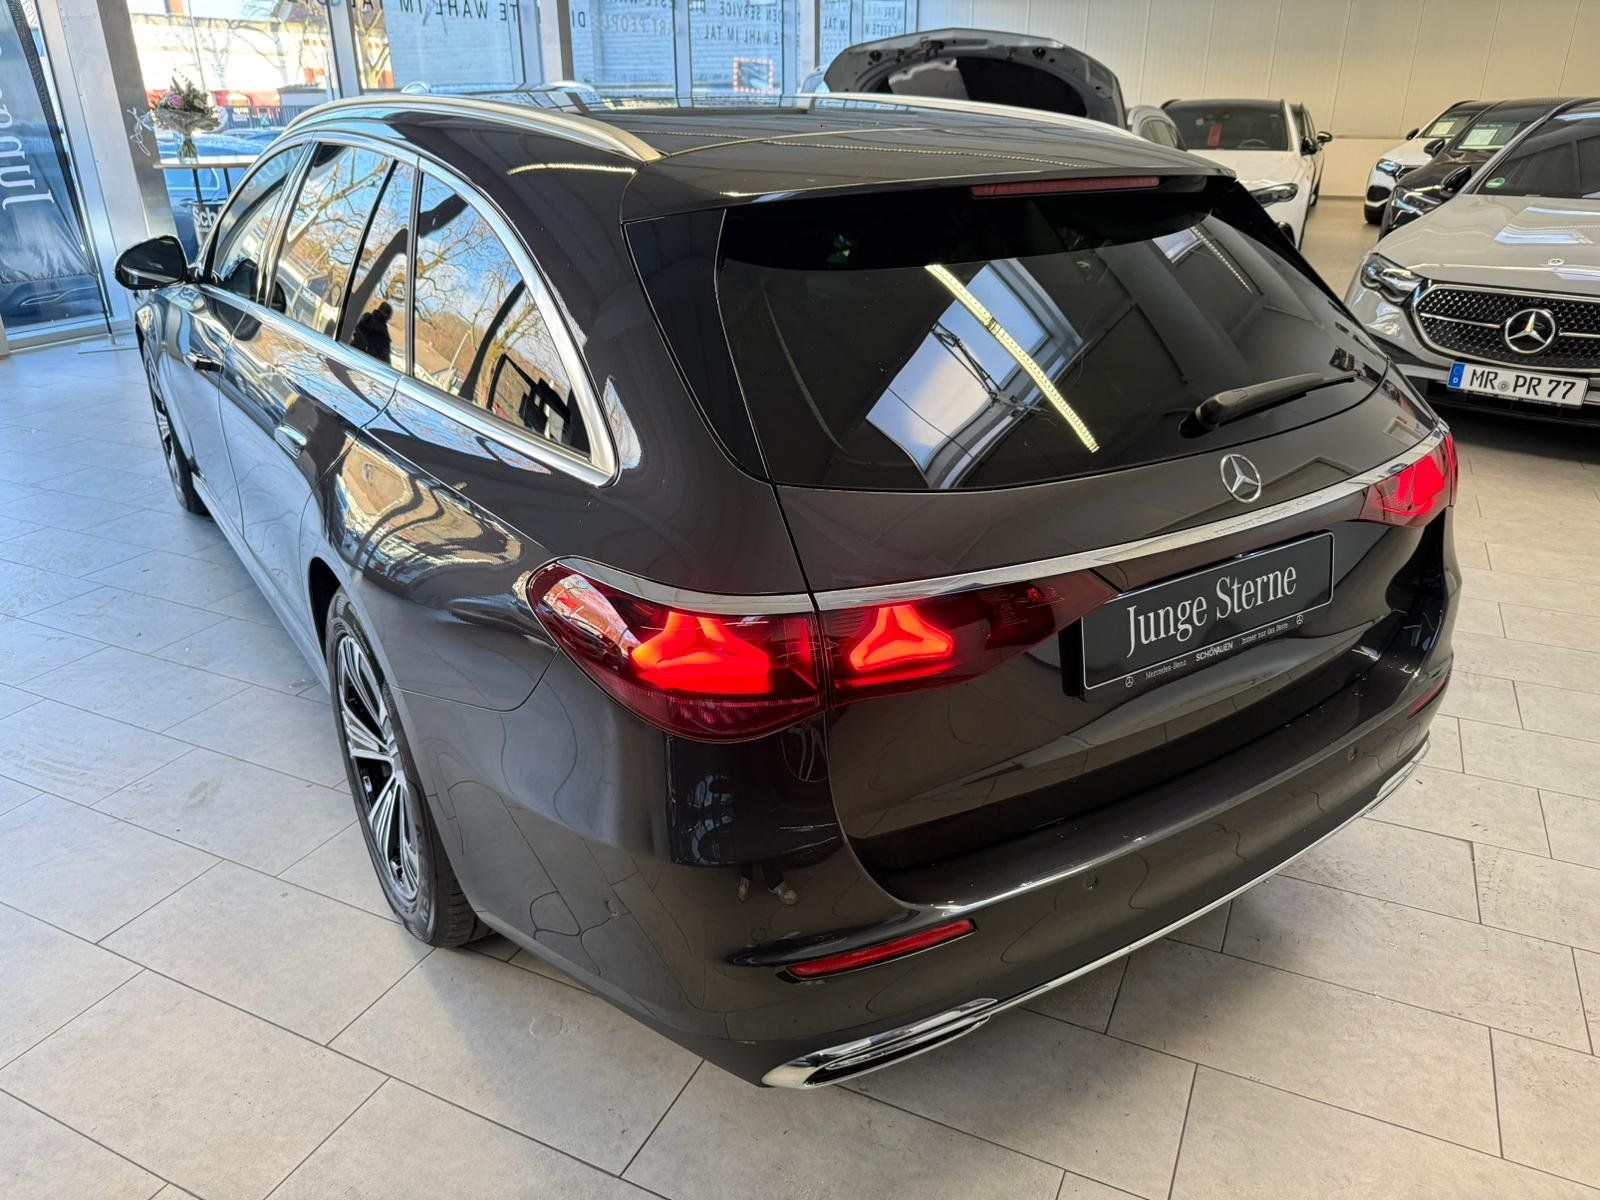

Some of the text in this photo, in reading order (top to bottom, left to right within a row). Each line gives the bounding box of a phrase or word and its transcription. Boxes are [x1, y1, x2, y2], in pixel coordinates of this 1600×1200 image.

[1469, 368, 1499, 390] MR
[1512, 374, 1542, 396] PR
[1547, 380, 1577, 400] 77
[1127, 565, 1297, 658] Junge Sterne
